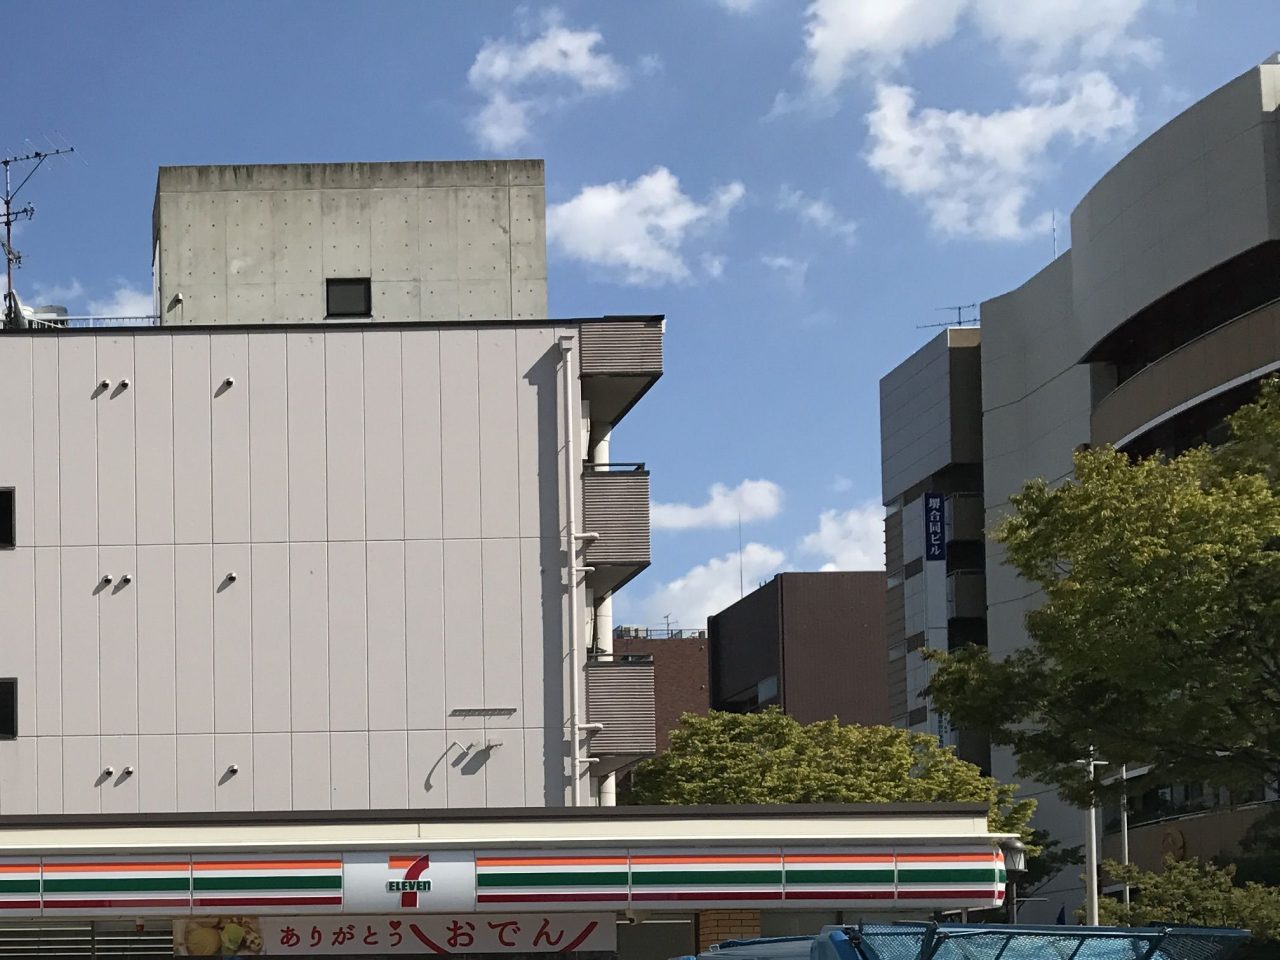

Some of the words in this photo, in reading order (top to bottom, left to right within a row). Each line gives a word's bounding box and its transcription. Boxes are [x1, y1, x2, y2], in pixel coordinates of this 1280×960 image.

[929, 497, 941, 556] 堺合同ビル
[280, 921, 402, 947] ありがとう
[447, 918, 564, 947] おでん
